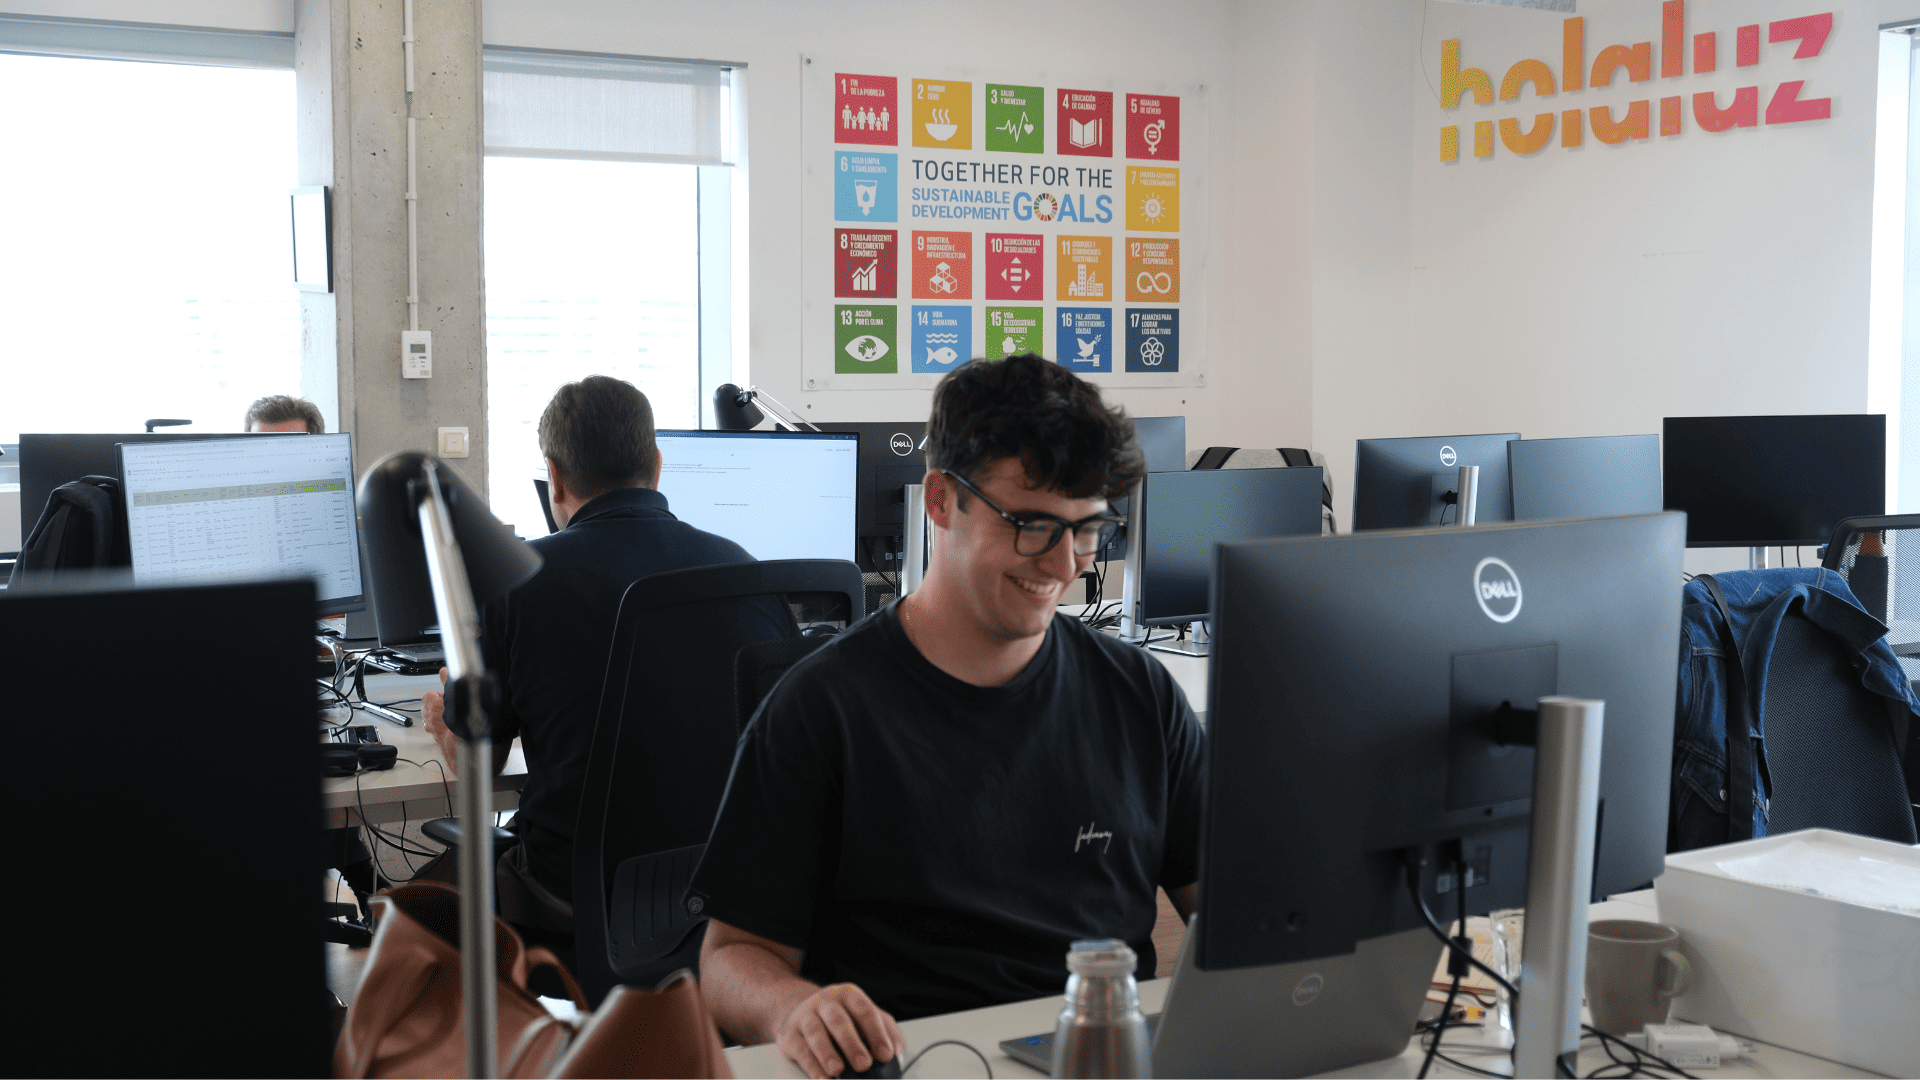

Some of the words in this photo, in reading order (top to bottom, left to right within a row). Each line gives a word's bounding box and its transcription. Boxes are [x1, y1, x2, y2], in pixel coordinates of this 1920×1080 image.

[841, 79, 846, 94] 1
[1440, 0, 1833, 162] holaluz
[864, 88, 885, 97] POBREZA
[917, 84, 924, 100] 2
[991, 89, 997, 104] 3
[1004, 97, 1026, 105] BIENESTAR
[1062, 93, 1069, 110] 4
[1078, 102, 1096, 110] CALIDAD
[1131, 98, 1137, 113] 5
[841, 156, 848, 172] 6
[912, 159, 1023, 185] TOGETHER
[1030, 165, 1069, 187] FOR
[1076, 168, 1112, 188] THE
[1131, 171, 1136, 185] 7
[912, 187, 1010, 204] SUSTAINABLE
[912, 204, 1010, 220] DEVELOPMENT
[1013, 192, 1113, 223] GOALS
[841, 234, 848, 249] 8
[850, 234, 871, 242] TRABAJO
[871, 234, 892, 242] DECENTE
[917, 236, 924, 251] 9
[991, 238, 1002, 253] 10
[927, 251, 966, 259] INFRAESTRUCTURA
[1062, 240, 1070, 255] 11
[1131, 242, 1140, 257] 12
[840, 309, 852, 325] 13
[917, 311, 929, 326] 14
[991, 311, 1001, 326] 15
[1062, 312, 1072, 327] 16
[1131, 313, 1140, 327] 17
[1481, 580, 1518, 600] DELL
